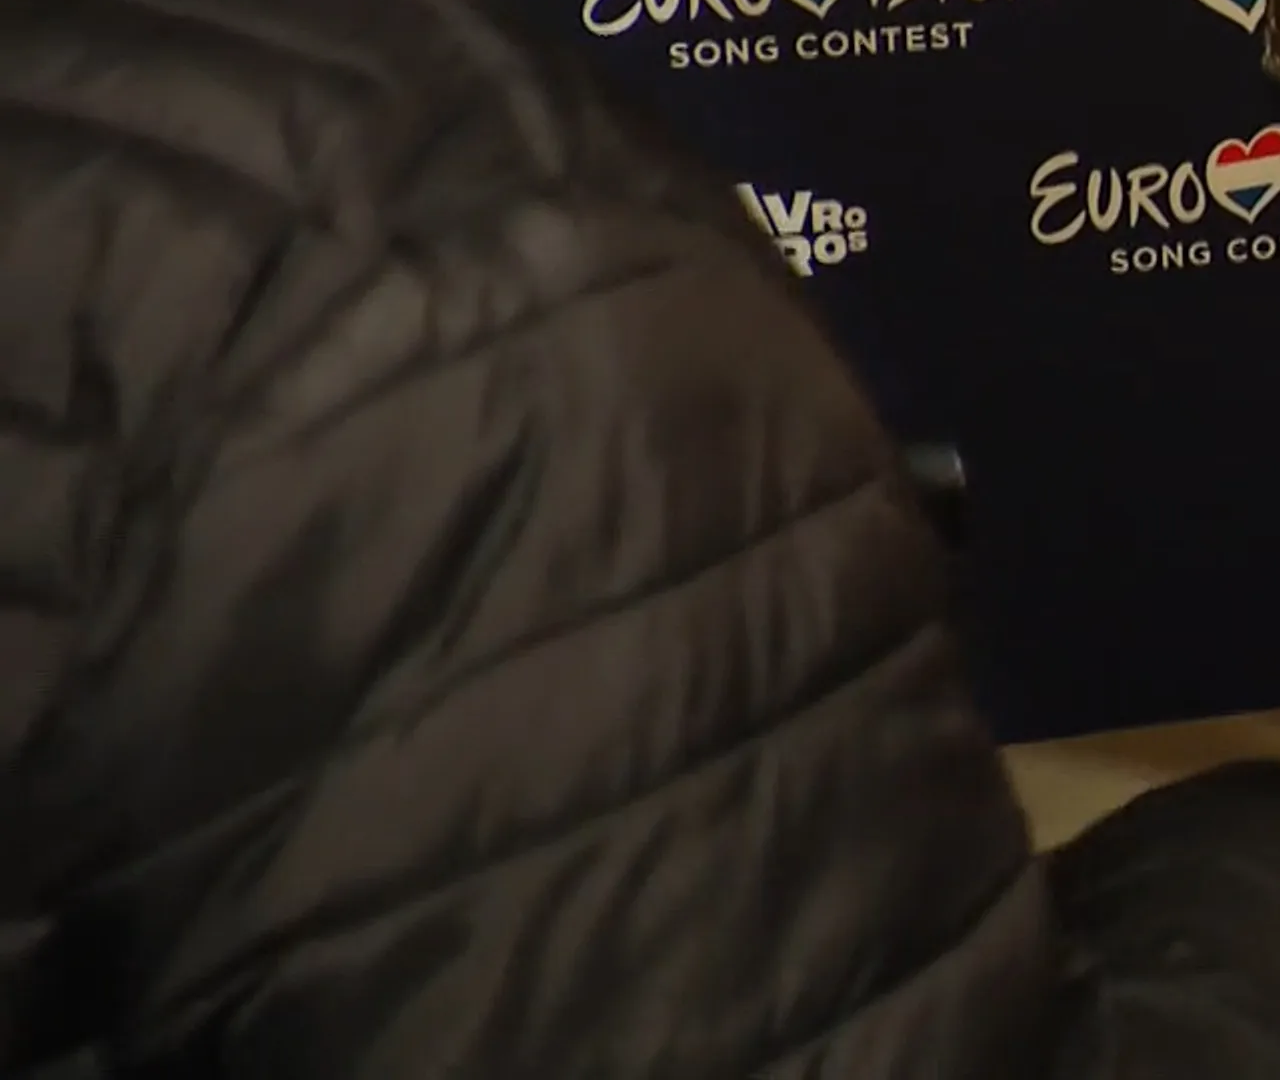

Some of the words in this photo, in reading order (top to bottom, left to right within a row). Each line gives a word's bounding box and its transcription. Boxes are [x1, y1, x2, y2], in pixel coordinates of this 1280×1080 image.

[669, 36, 779, 68] SONG
[796, 22, 973, 59] CONTEST
[735, 181, 867, 237] VRO
[773, 230, 868, 278] ROS
[1111, 240, 1211, 273] SONG
